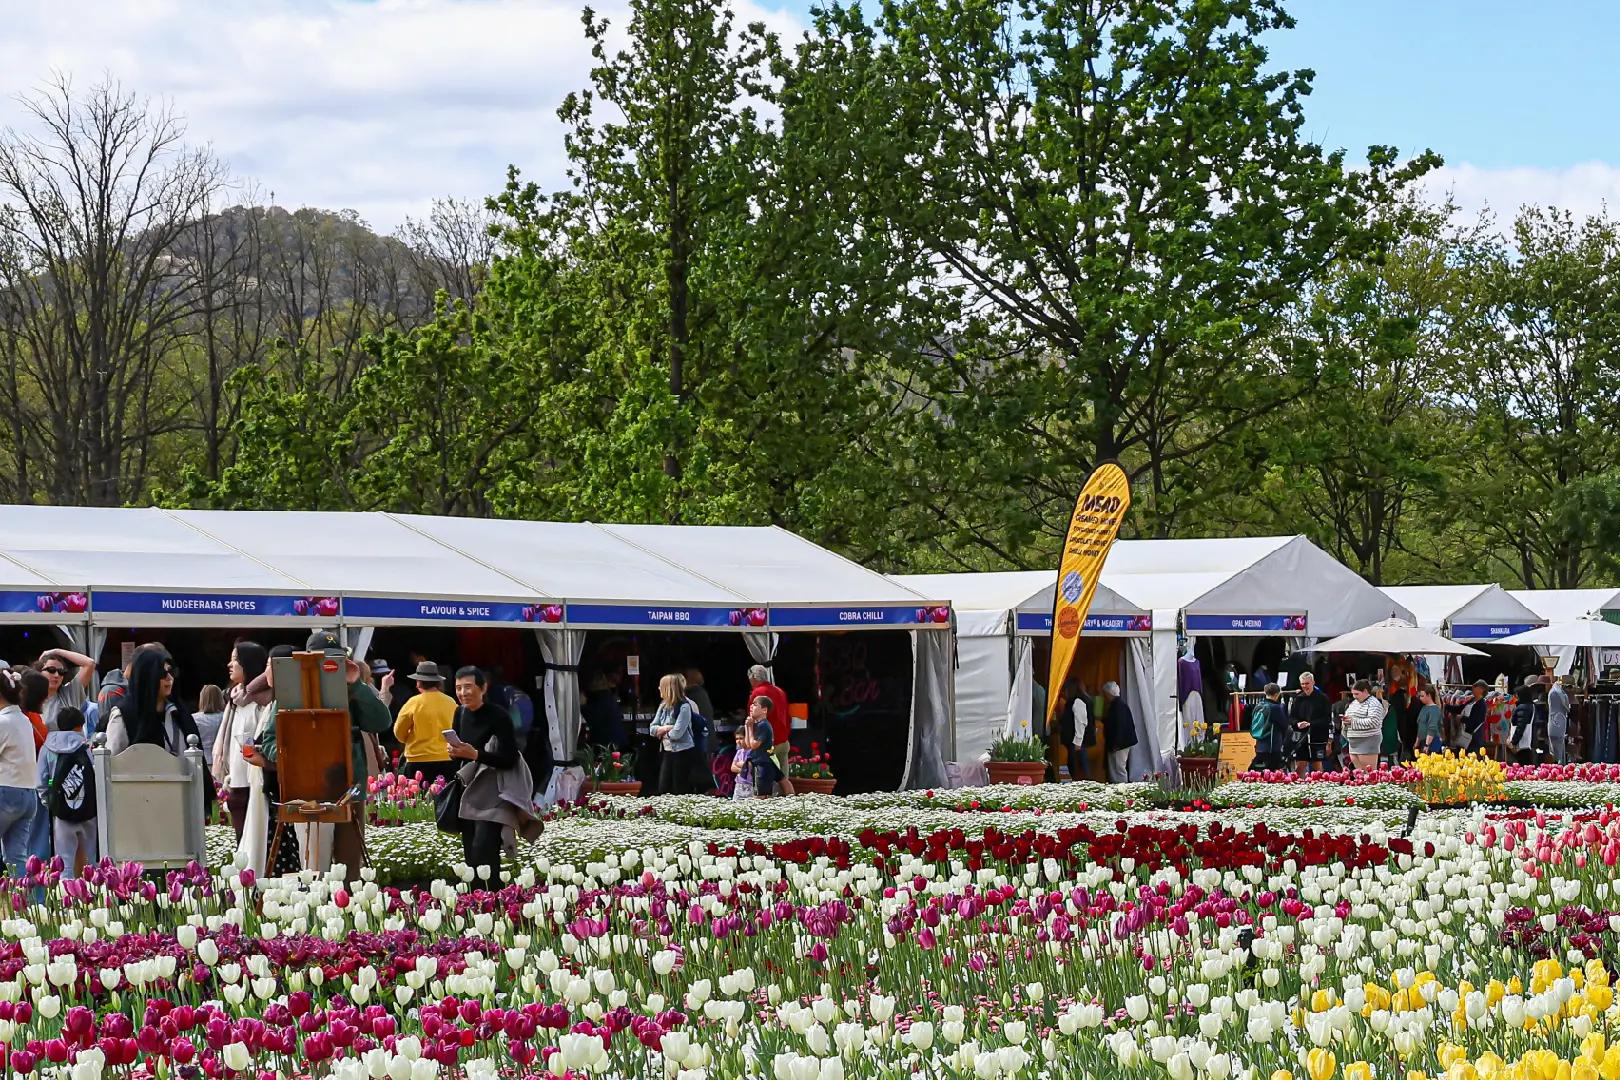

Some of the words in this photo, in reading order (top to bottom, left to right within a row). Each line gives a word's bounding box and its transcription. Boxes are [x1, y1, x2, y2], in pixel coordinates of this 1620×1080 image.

[1081, 494, 1121, 513] MEAD
[162, 599, 223, 609] MUDGEERABA
[224, 600, 256, 610] SPICES
[421, 605, 457, 615] FLAVOUR
[458, 607, 465, 616] &
[466, 607, 490, 616] SPICE
[648, 611, 673, 621] TAIPAN
[674, 611, 690, 621] BBQ
[839, 611, 862, 621] COBRA
[862, 611, 884, 620] CHILLI
[1101, 619, 1124, 628] MEADERY
[1231, 619, 1244, 628] OPAL
[61, 764, 85, 799] NIKE
